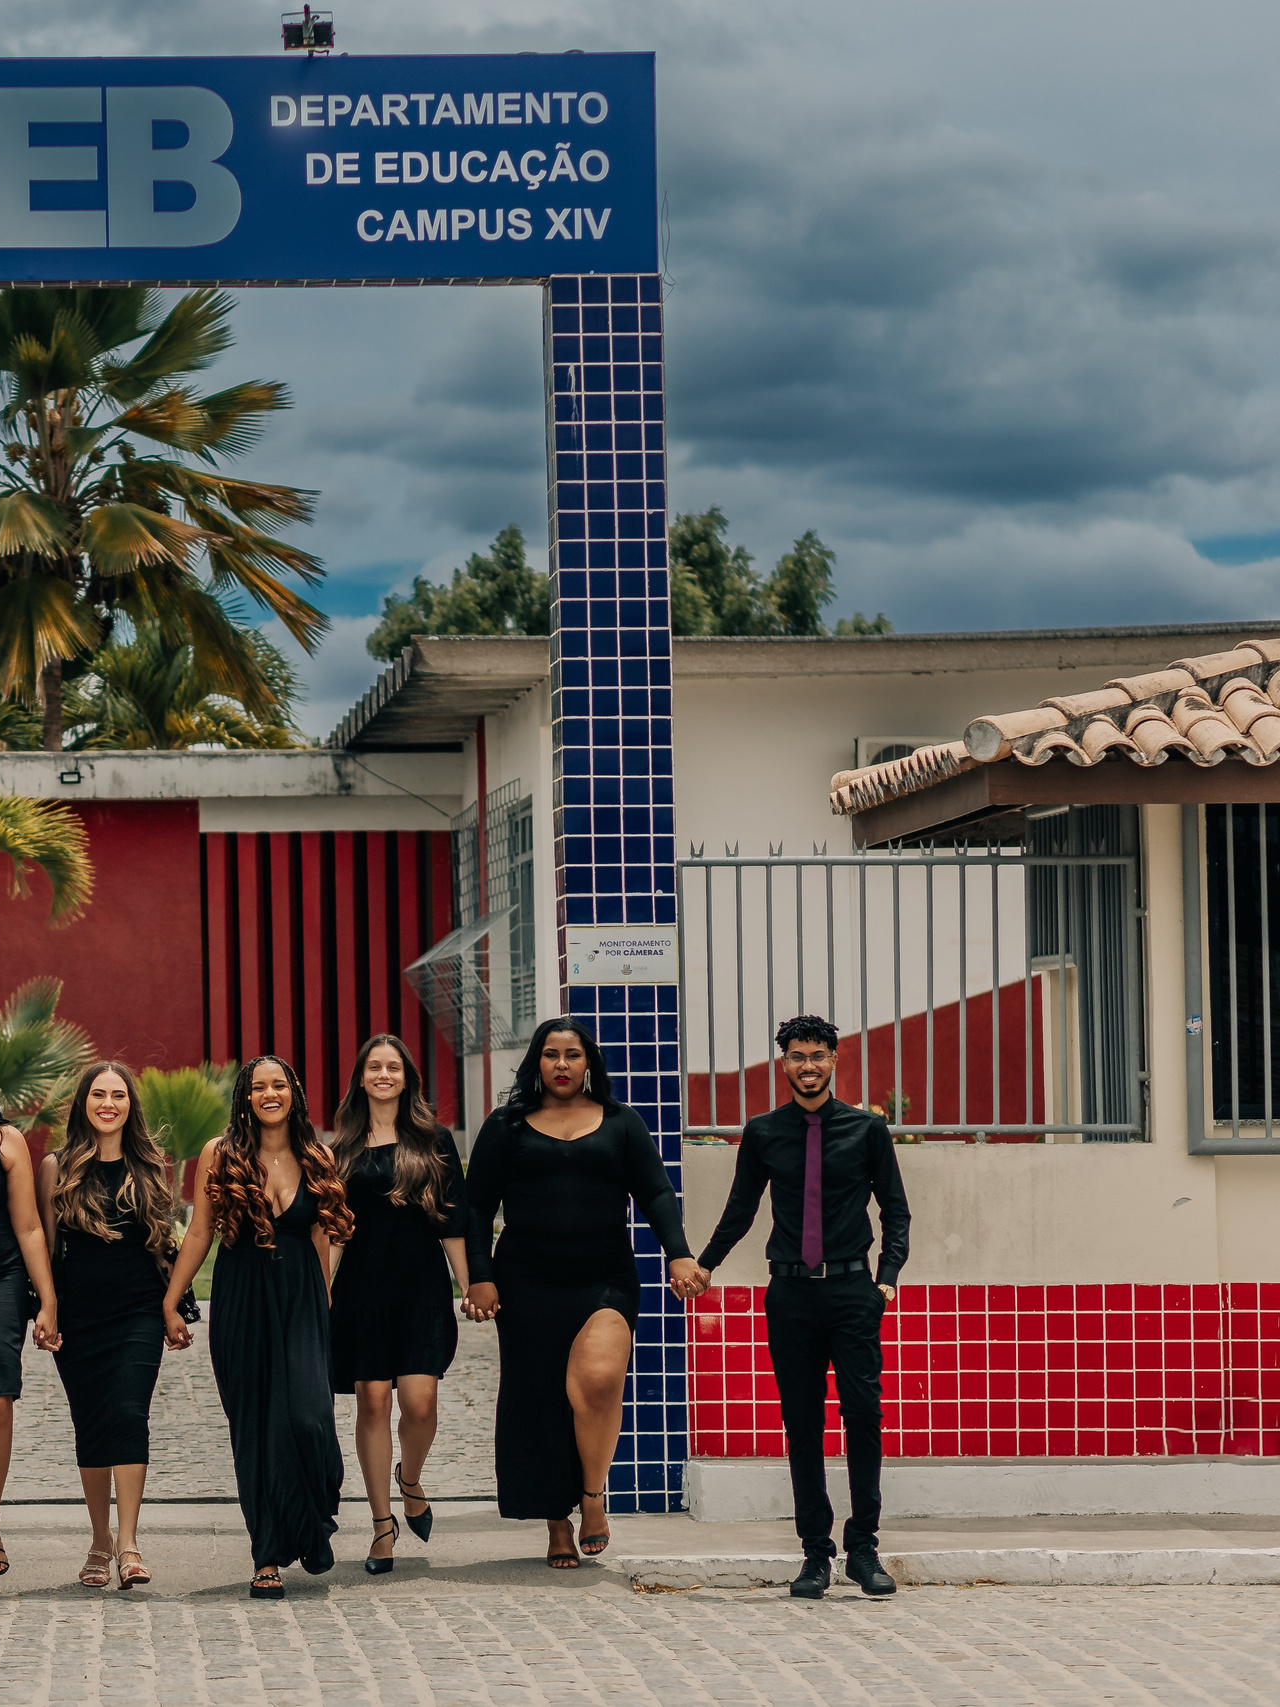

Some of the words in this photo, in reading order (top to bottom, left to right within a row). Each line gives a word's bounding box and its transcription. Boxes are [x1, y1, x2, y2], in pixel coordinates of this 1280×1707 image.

[270, 91, 609, 128] DEPARTAMENTO
[306, 151, 361, 186] DE
[374, 142, 610, 191] EDUCAÇÃO
[356, 207, 533, 243] CAMPUS
[544, 207, 612, 241] XIV
[598, 940, 672, 948] MONITORAMENTO
[605, 949, 622, 957] POR
[623, 948, 664, 957] CÂMERAS
